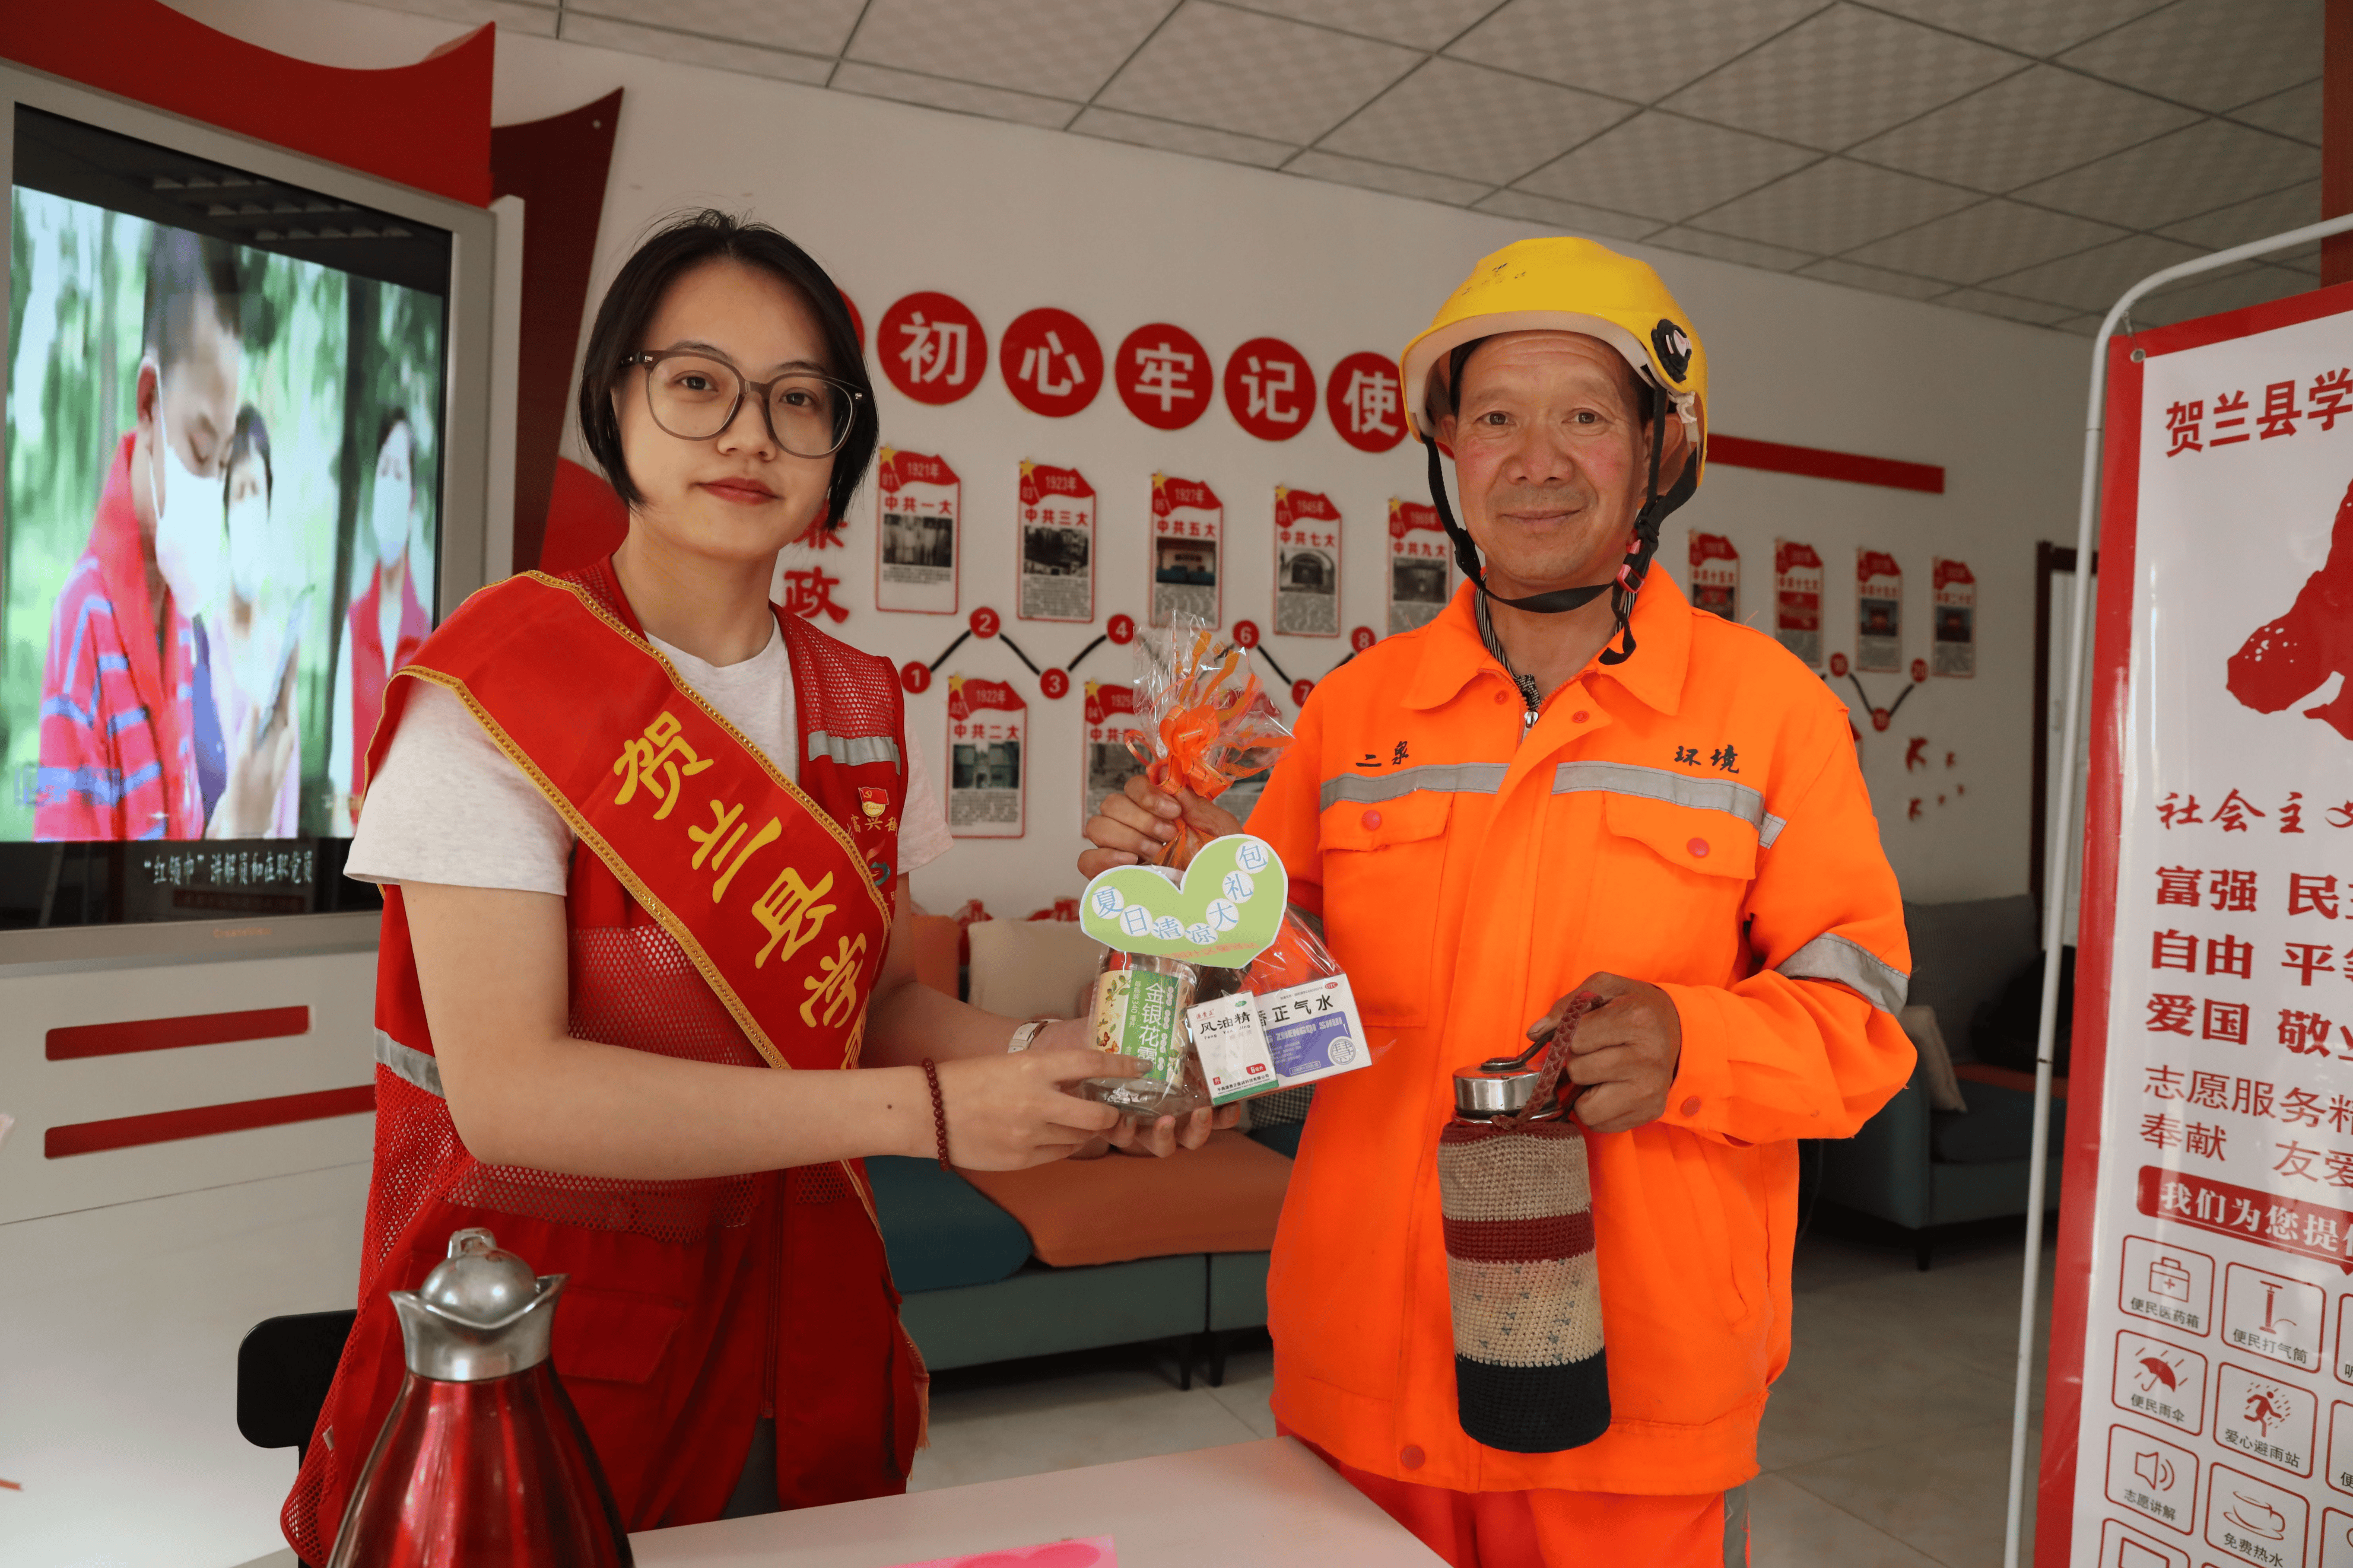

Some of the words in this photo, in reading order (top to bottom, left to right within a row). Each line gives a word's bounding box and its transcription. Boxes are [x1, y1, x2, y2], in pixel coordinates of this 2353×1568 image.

[898, 311, 1399, 438] 初心牢记使
[2165, 368, 2353, 457] 贺兰县学
[884, 496, 952, 514] 中共一大
[1025, 508, 1088, 526] 中共三大
[1157, 520, 1216, 537] 中共五大
[1279, 530, 1335, 548] 中共七大
[1393, 541, 1446, 557] 中共九大
[979, 615, 992, 631] 2
[1115, 620, 1128, 638] 4
[1240, 626, 1252, 644] 6
[1358, 632, 1370, 649] 8
[910, 670, 922, 687] 1
[1048, 675, 1060, 694] 3
[1299, 685, 1310, 702] 7
[954, 723, 1020, 740] 中共二大
[1674, 745, 1739, 774] 环境
[1092, 844, 1268, 943] 夏日清凉大礼包
[2155, 866, 2257, 912] 富强
[2288, 872, 2353, 920] 民
[2152, 929, 2253, 979] 自由
[2281, 942, 2353, 986] 平
[1200, 1011, 1251, 1034] 风油精
[1276, 1023, 1316, 1041] ZHENGQI
[1319, 1016, 1343, 1030] SHUI
[2145, 993, 2250, 1045] 爱国
[2277, 1008, 2353, 1058] 敬
[2140, 1113, 2227, 1161] 奉献
[2130, 1297, 2199, 1330] 便民医药箱
[2233, 1328, 2308, 1364] 便民打气筒
[2130, 1394, 2185, 1423] 便民雨伞
[2224, 1428, 2300, 1468] 爱心避雨站
[2123, 1489, 2176, 1522] 志愿讲解
[2224, 1532, 2284, 1567] 免费热水
